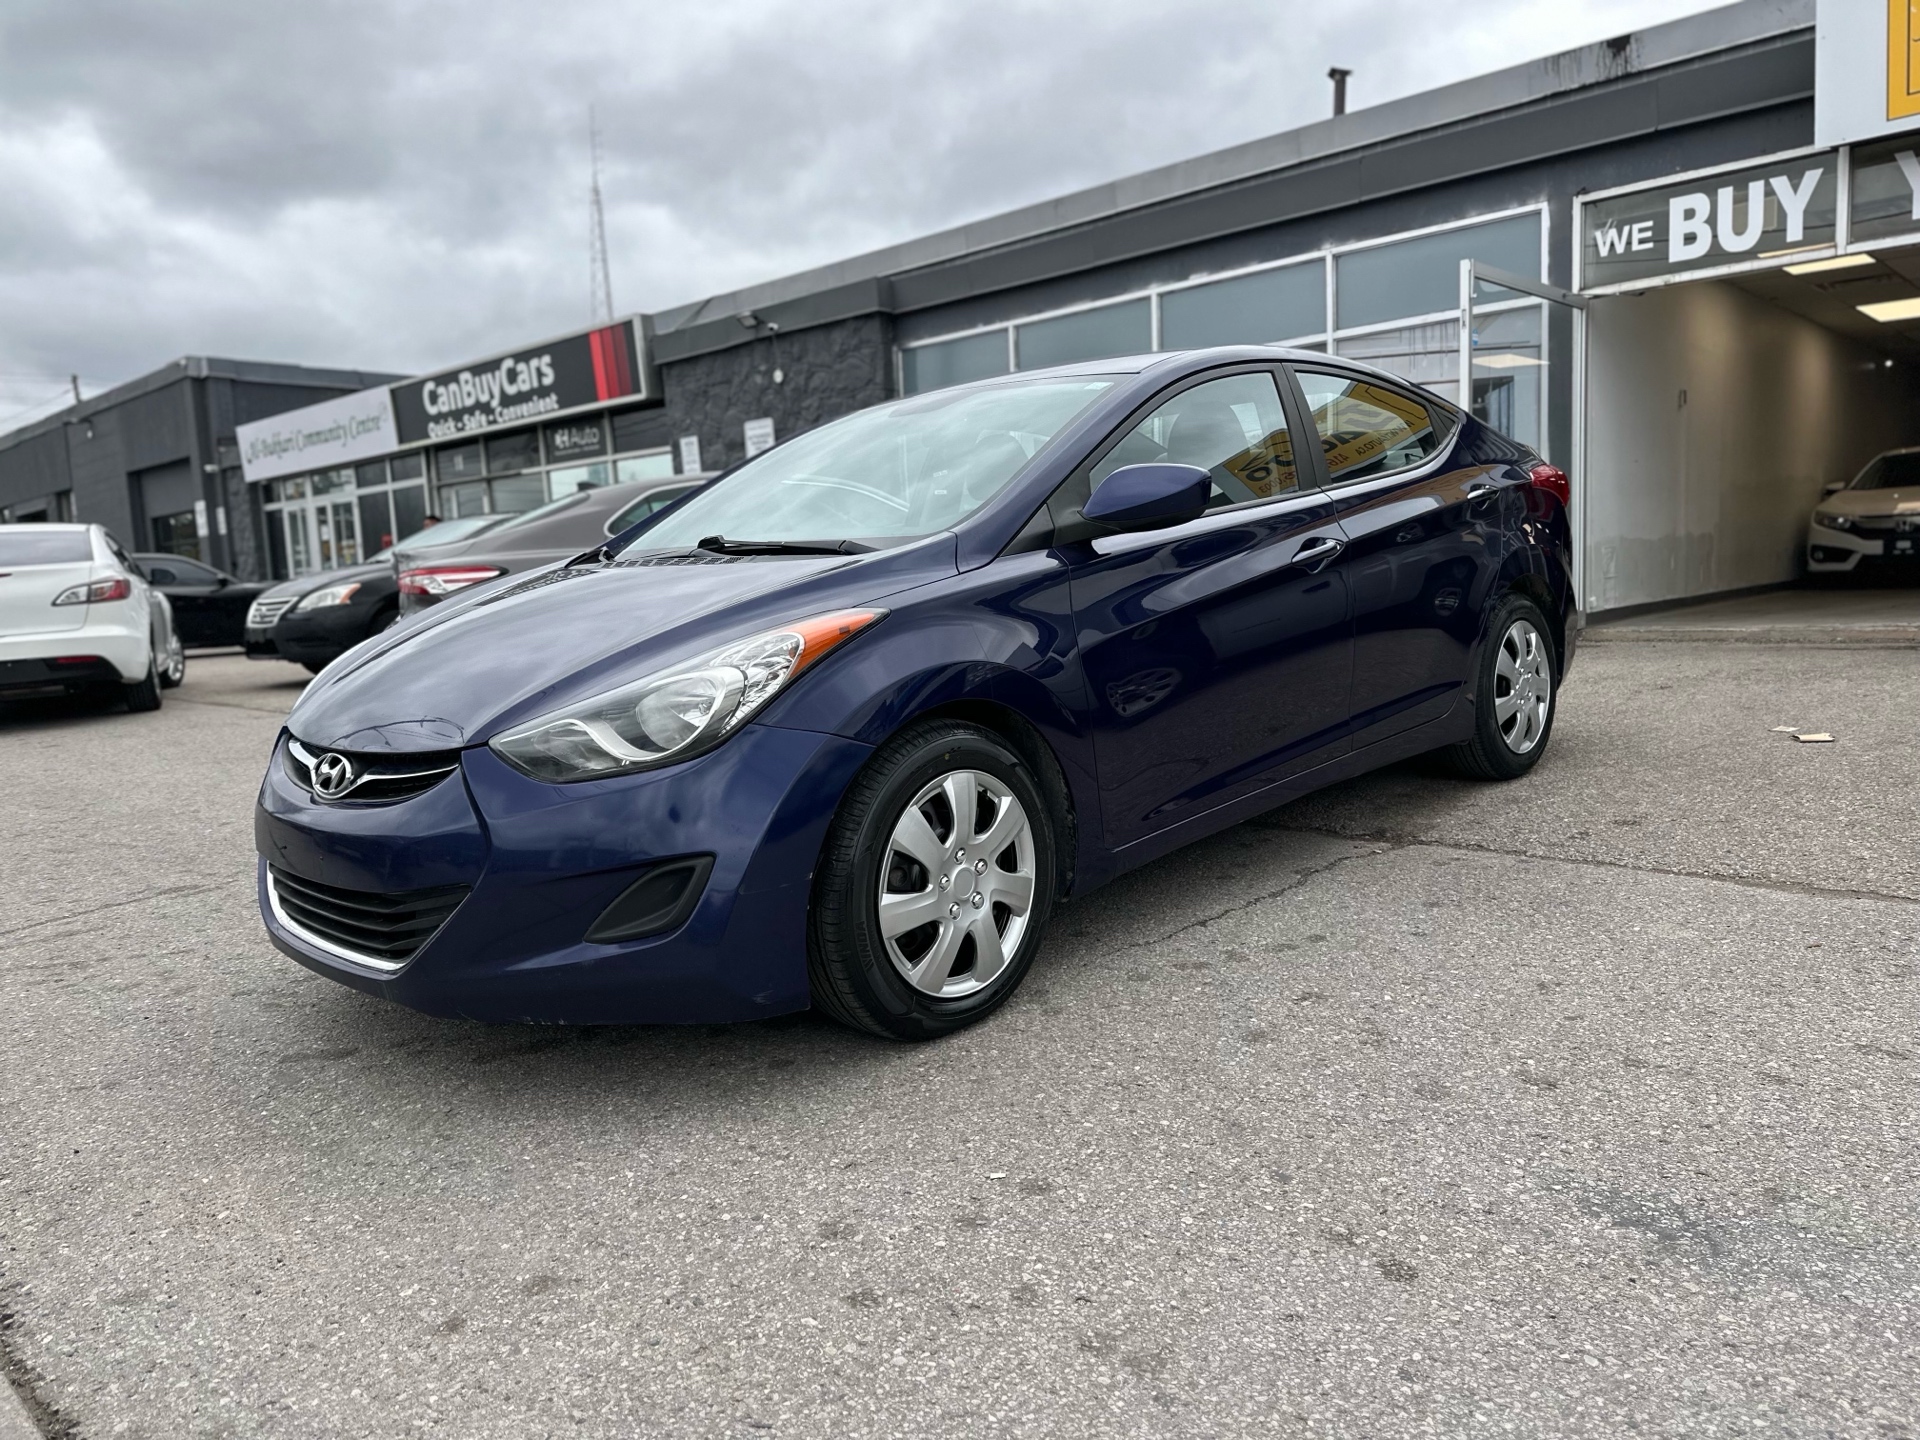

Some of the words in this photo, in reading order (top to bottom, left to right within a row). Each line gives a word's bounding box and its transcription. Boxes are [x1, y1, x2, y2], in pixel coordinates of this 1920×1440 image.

[1595, 220, 1655, 258] WE
[1668, 168, 1825, 264] BUY
[422, 354, 555, 416] CanBuyCars
[427, 417, 458, 440] Quick
[462, 410, 488, 431] Safe
[494, 392, 559, 423] Convenient
